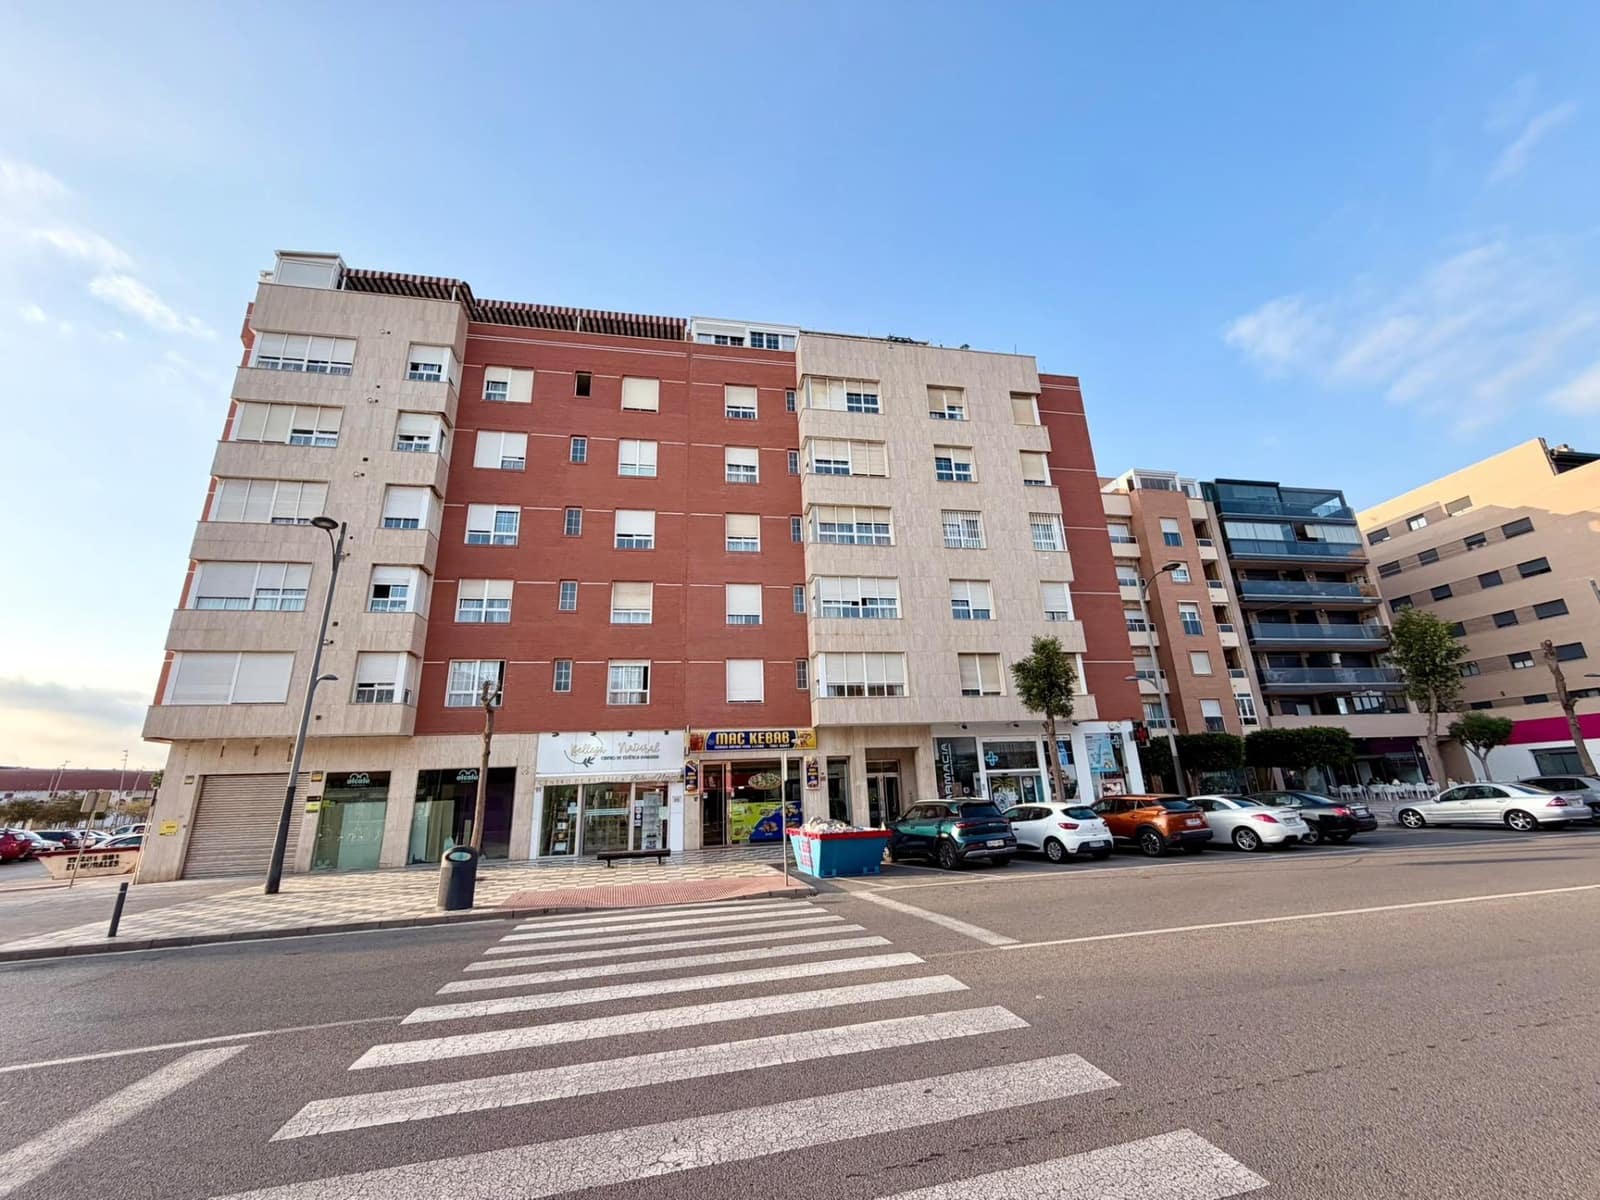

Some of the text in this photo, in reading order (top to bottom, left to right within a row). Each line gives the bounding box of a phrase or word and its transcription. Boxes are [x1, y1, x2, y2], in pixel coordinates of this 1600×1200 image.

[715, 731, 790, 745] MAC KEBAB
[618, 741, 661, 754] Natural
[941, 743, 953, 800] ARMACIA
